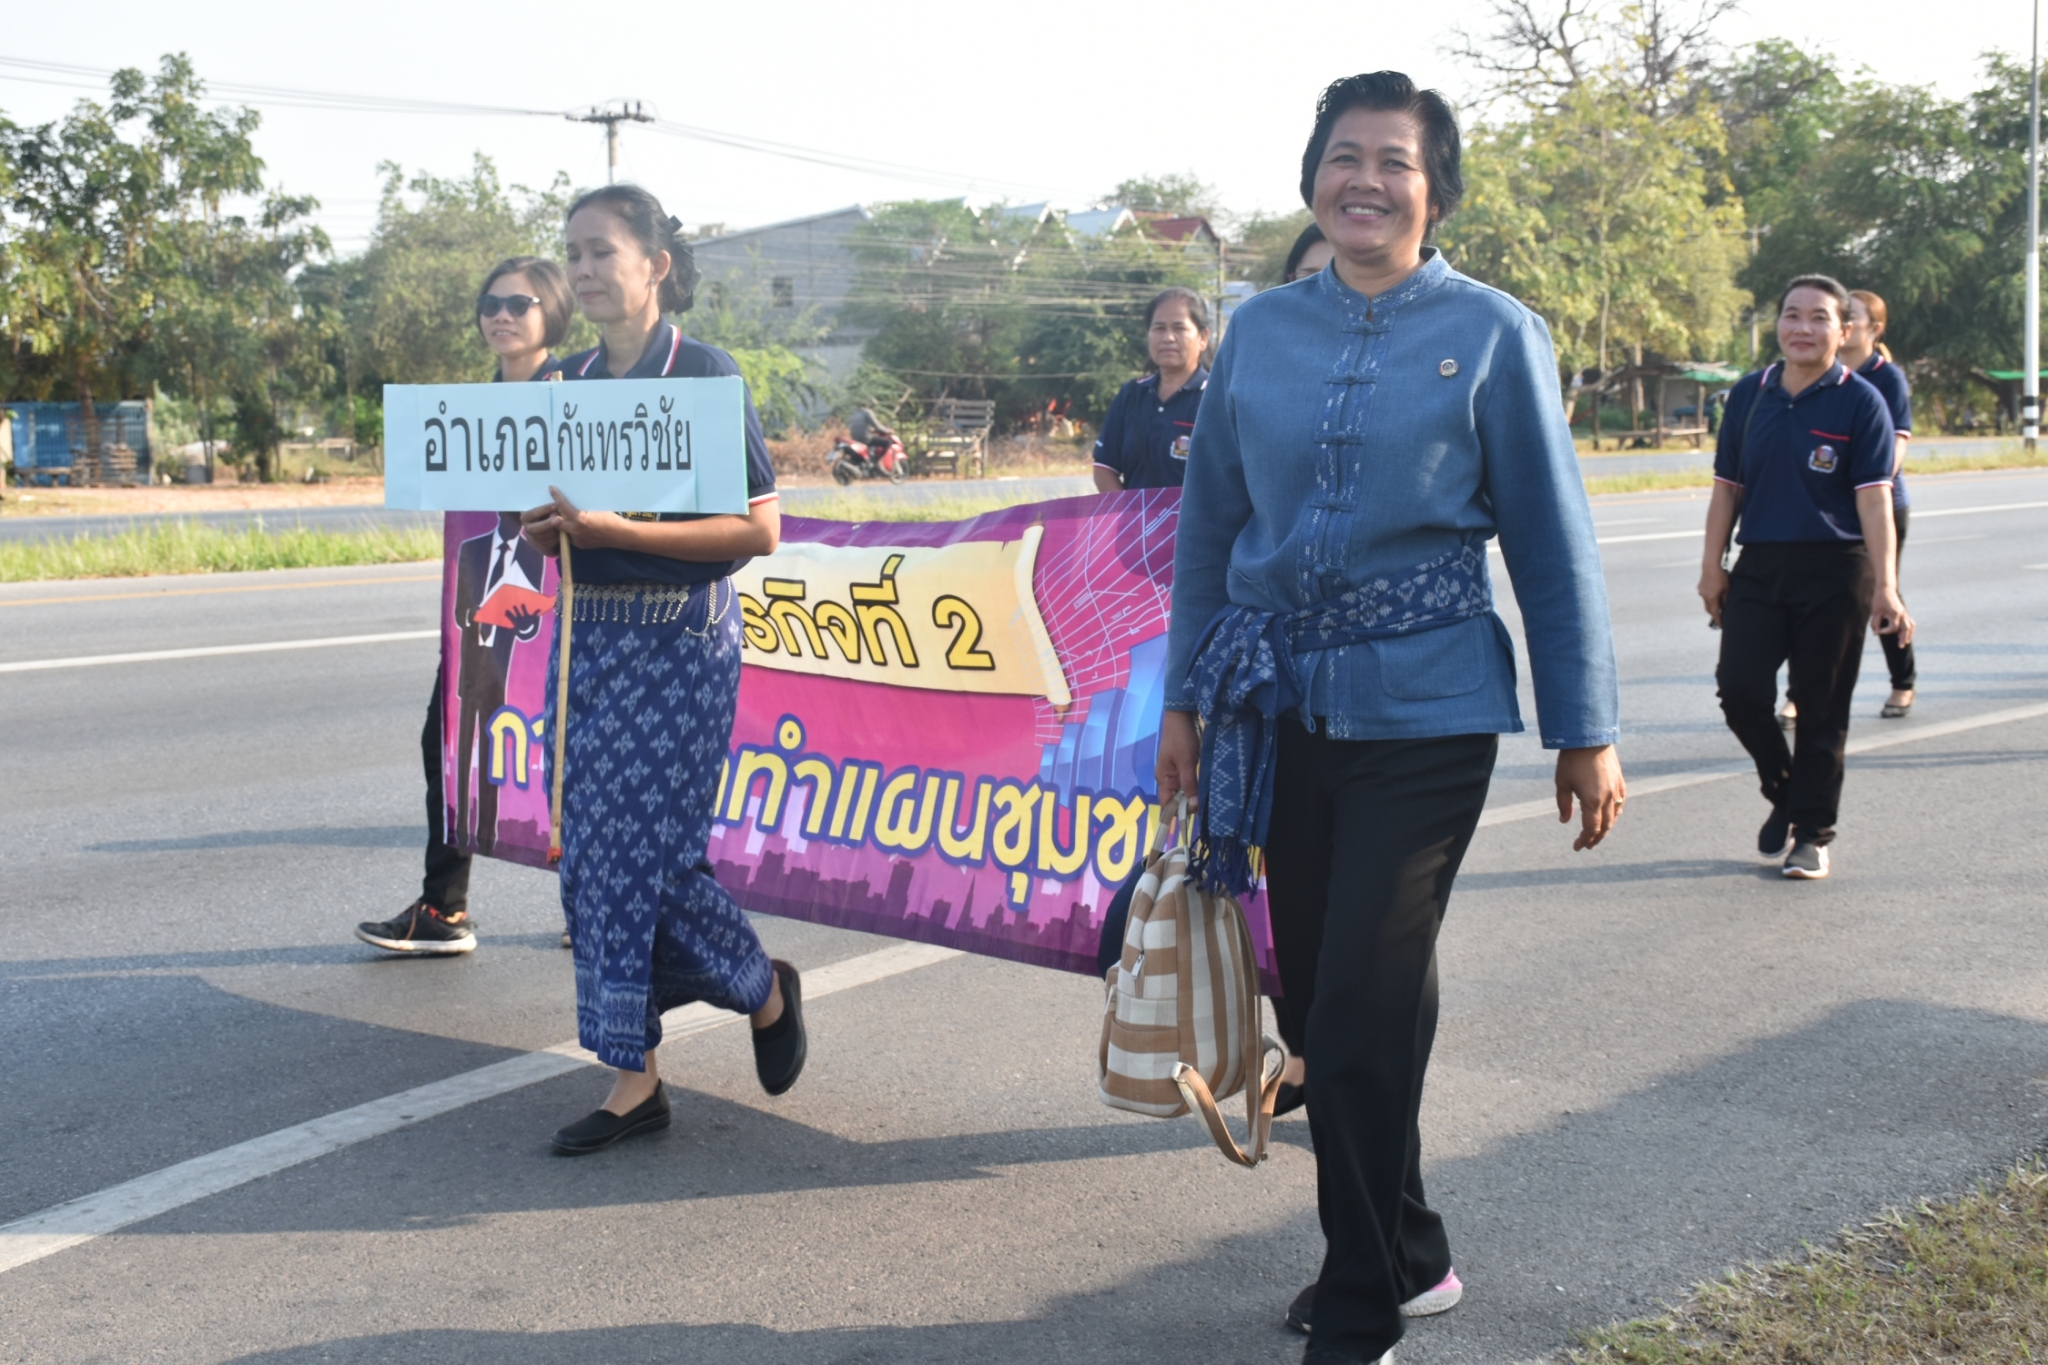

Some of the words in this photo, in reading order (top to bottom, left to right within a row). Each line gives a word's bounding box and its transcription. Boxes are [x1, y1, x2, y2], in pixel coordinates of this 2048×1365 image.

[738, 554, 920, 669] รกิจที่
[931, 593, 996, 671] 2
